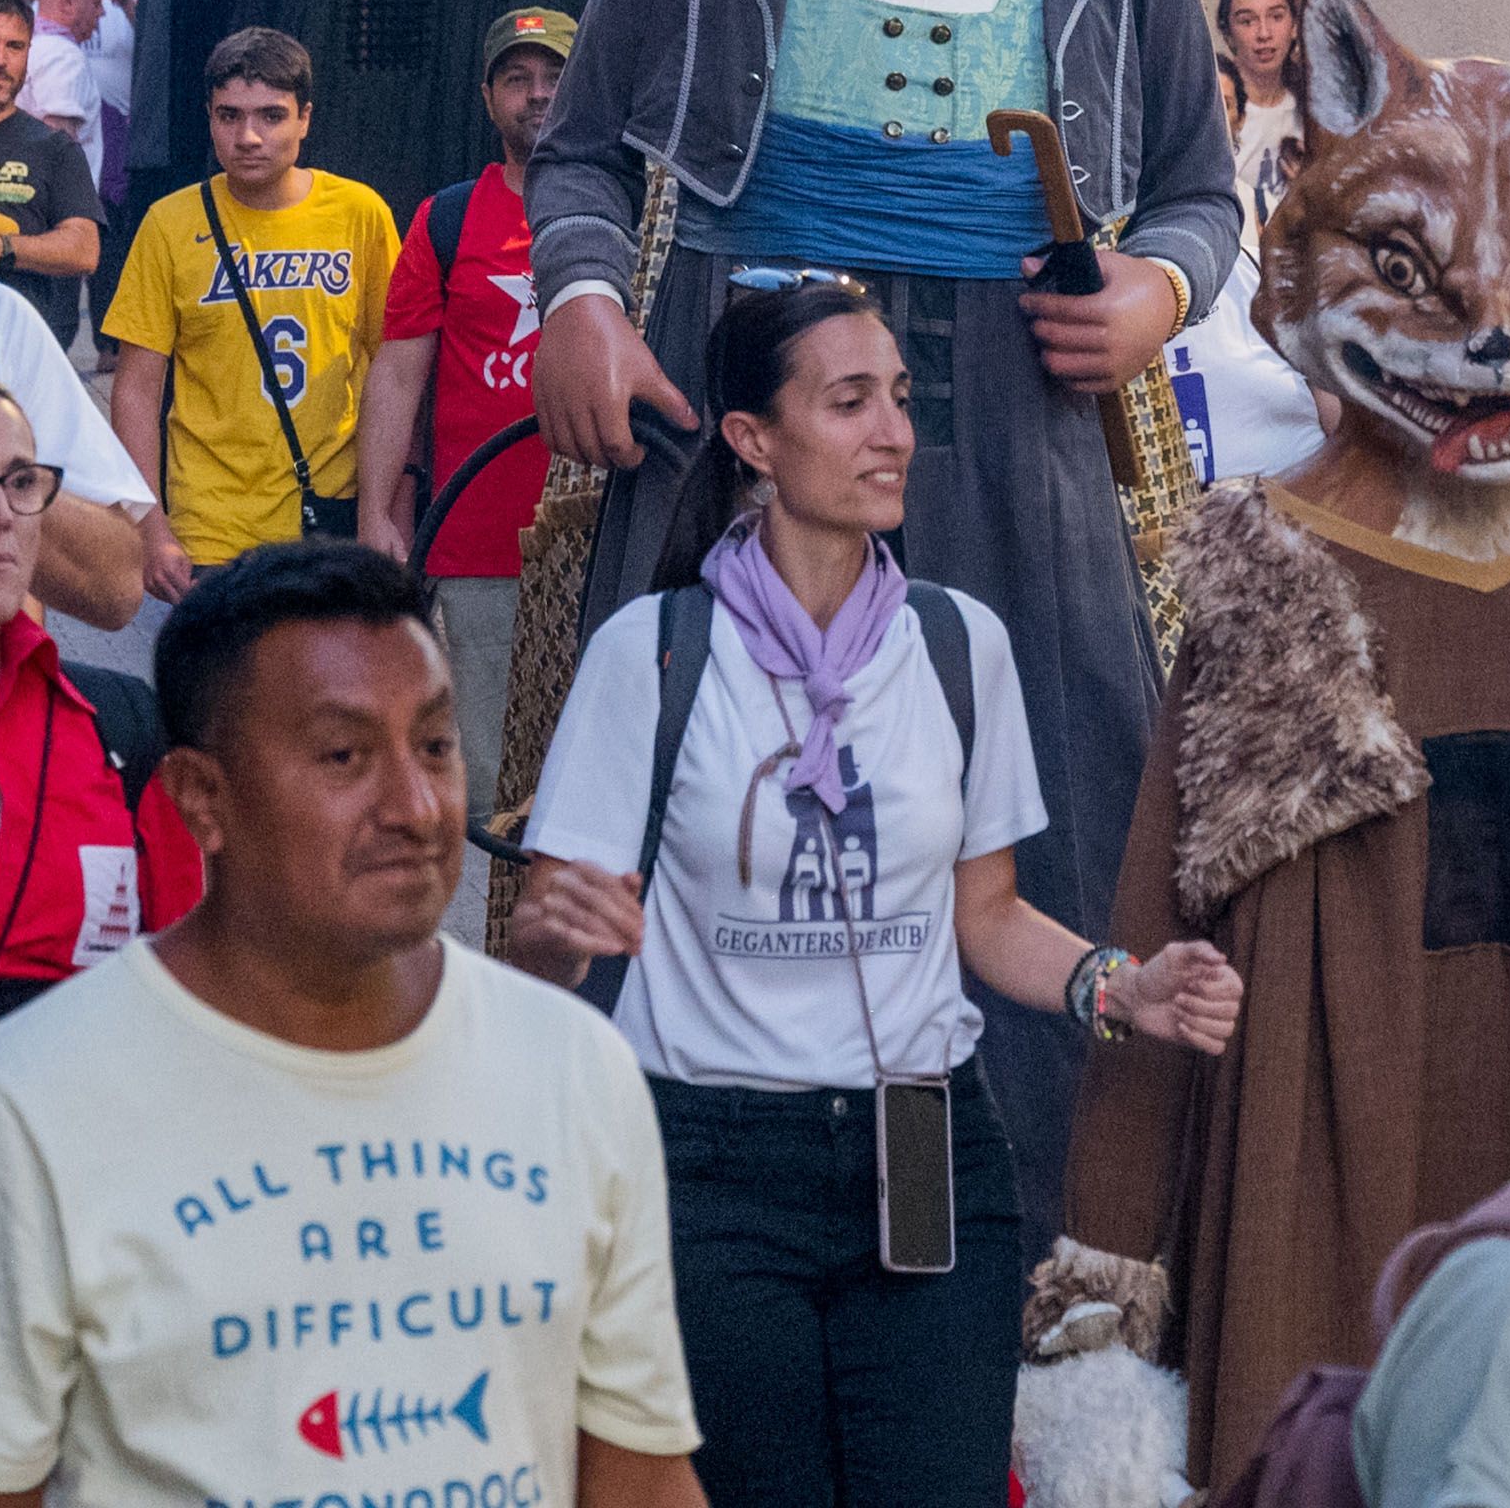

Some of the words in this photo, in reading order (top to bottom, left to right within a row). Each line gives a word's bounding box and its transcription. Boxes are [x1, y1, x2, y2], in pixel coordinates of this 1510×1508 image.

[199, 242, 352, 304] LAKERS
[260, 315, 307, 409] 6
[715, 926, 845, 954] GEGANTERS
[174, 1160, 290, 1237] ALL
[315, 1140, 550, 1205] THINGS
[299, 1208, 445, 1261] ARE
[212, 1279, 557, 1360] DIFFICULT
